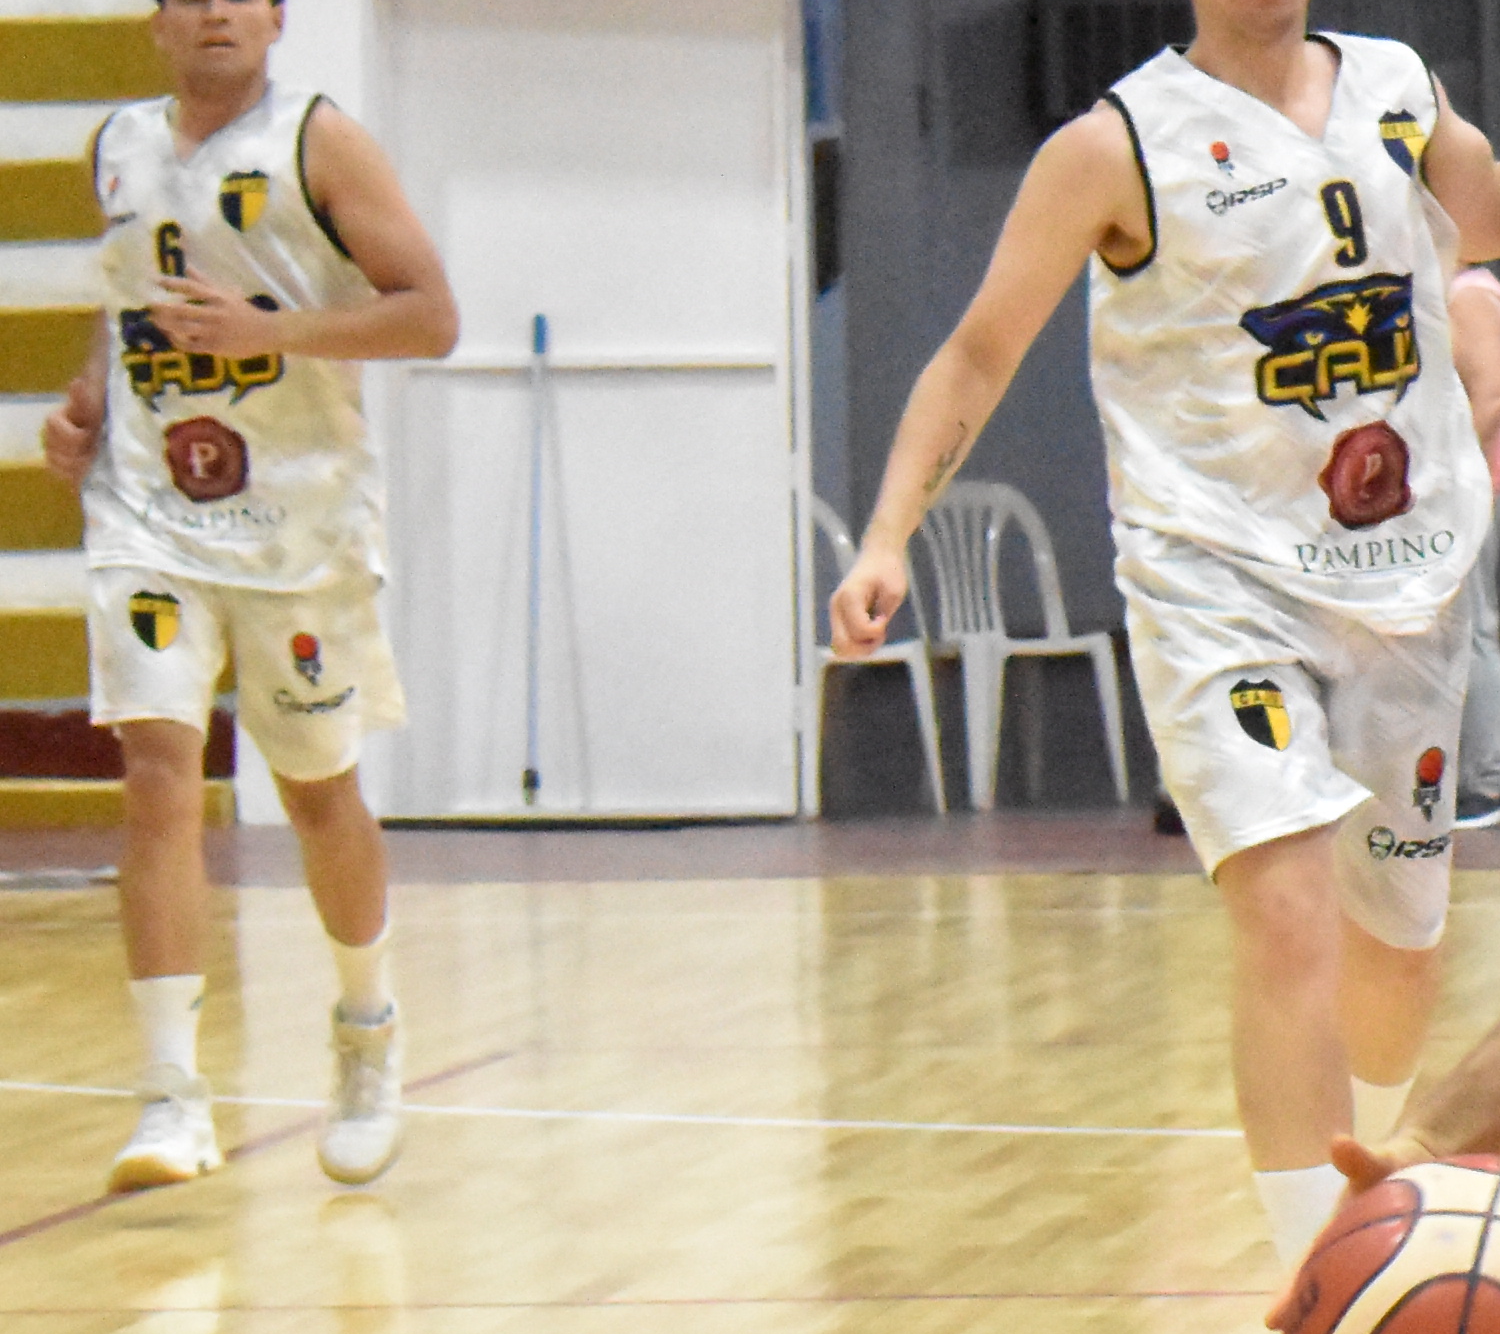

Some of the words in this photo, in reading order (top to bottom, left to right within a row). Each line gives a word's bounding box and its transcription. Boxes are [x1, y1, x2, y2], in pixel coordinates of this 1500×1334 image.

[156, 221, 188, 280] 6
[1320, 179, 1368, 268] 9
[1294, 530, 1455, 573] PAMPINO
